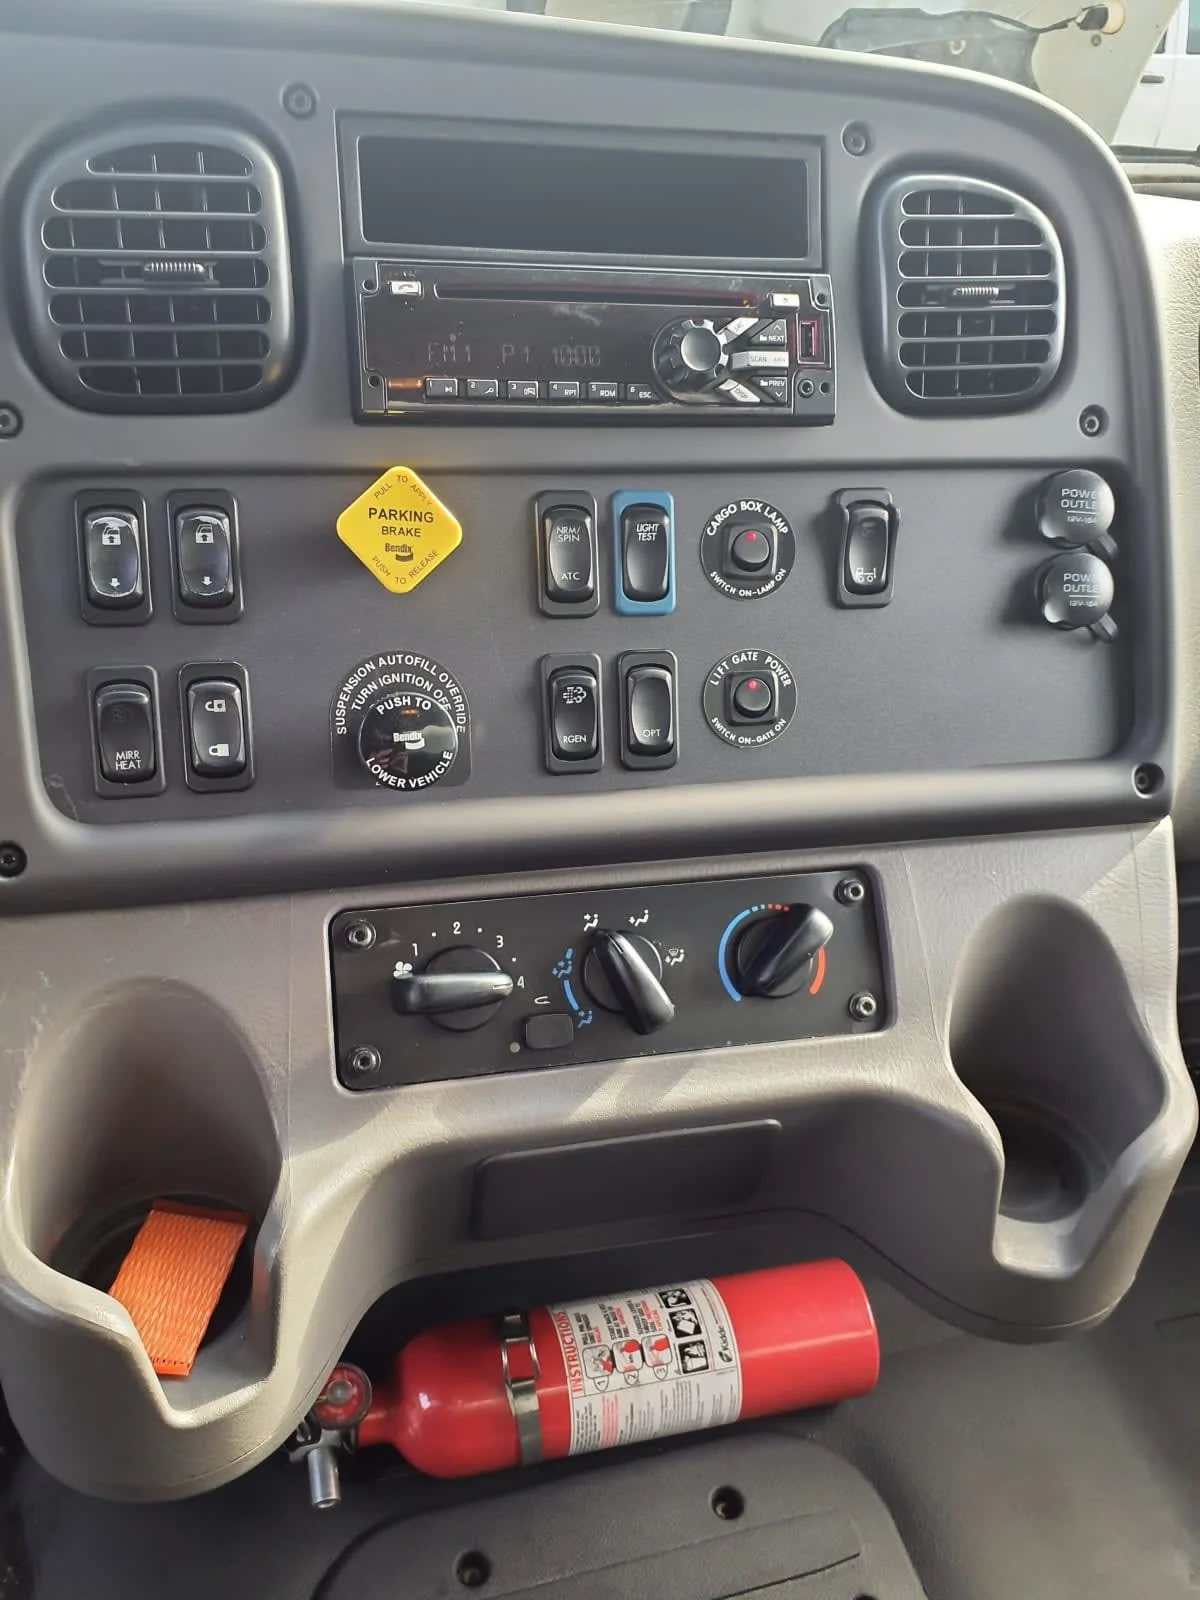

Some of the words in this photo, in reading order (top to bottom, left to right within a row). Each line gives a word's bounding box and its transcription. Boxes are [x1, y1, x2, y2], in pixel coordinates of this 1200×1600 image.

[600, 389, 616, 397] RDM
[374, 483, 393, 500] PULL
[396, 474, 409, 484] TO
[1061, 488, 1096, 499] POWE
[1060, 499, 1097, 510] OUTLE
[368, 507, 434, 524] PARKING
[706, 504, 737, 536] CARGO
[740, 501, 763, 513] BOX
[764, 506, 789, 534] LAMP
[381, 525, 422, 538] BRAKE
[556, 525, 581, 534] NRM/
[636, 523, 660, 532] LIGHT
[557, 534, 580, 543] SPIN
[638, 532, 657, 542] TEST
[371, 554, 391, 577] PUSH
[395, 576, 407, 585] TO
[409, 549, 440, 578] RELEASE
[561, 571, 581, 581] ATC
[710, 571, 736, 594] SWITCH
[774, 568, 787, 581] ON
[1063, 584, 1101, 594] OUTLE
[710, 661, 730, 686] LIFT
[731, 651, 759, 664] GATE
[764, 656, 792, 687] POWER
[335, 661, 376, 735] SUSPENSION
[378, 655, 437, 676] AUTOFILL
[439, 673, 467, 733] OVERRIDE
[352, 681, 378, 711] TURN
[378, 673, 433, 692] IGNITION
[433, 689, 452, 711] OFF
[376, 696, 411, 715] PUSH
[415, 697, 432, 711] TO
[642, 728, 661, 737] OPT
[711, 717, 736, 741] SWITCH
[774, 718, 787, 732] ON
[393, 731, 423, 743] Bendix
[563, 735, 587, 744] RGEN
[116, 750, 140, 760] MIRR
[116, 760, 141, 770] HEAT
[366, 757, 406, 789] LOWER
[408, 751, 454, 789] VEHICLE
[453, 921, 461, 934] 2
[496, 935, 504, 948] 3
[412, 943, 418, 956] 1
[516, 975, 525, 989] 4
[556, 1311, 584, 1393] INSTRUCTIONS
